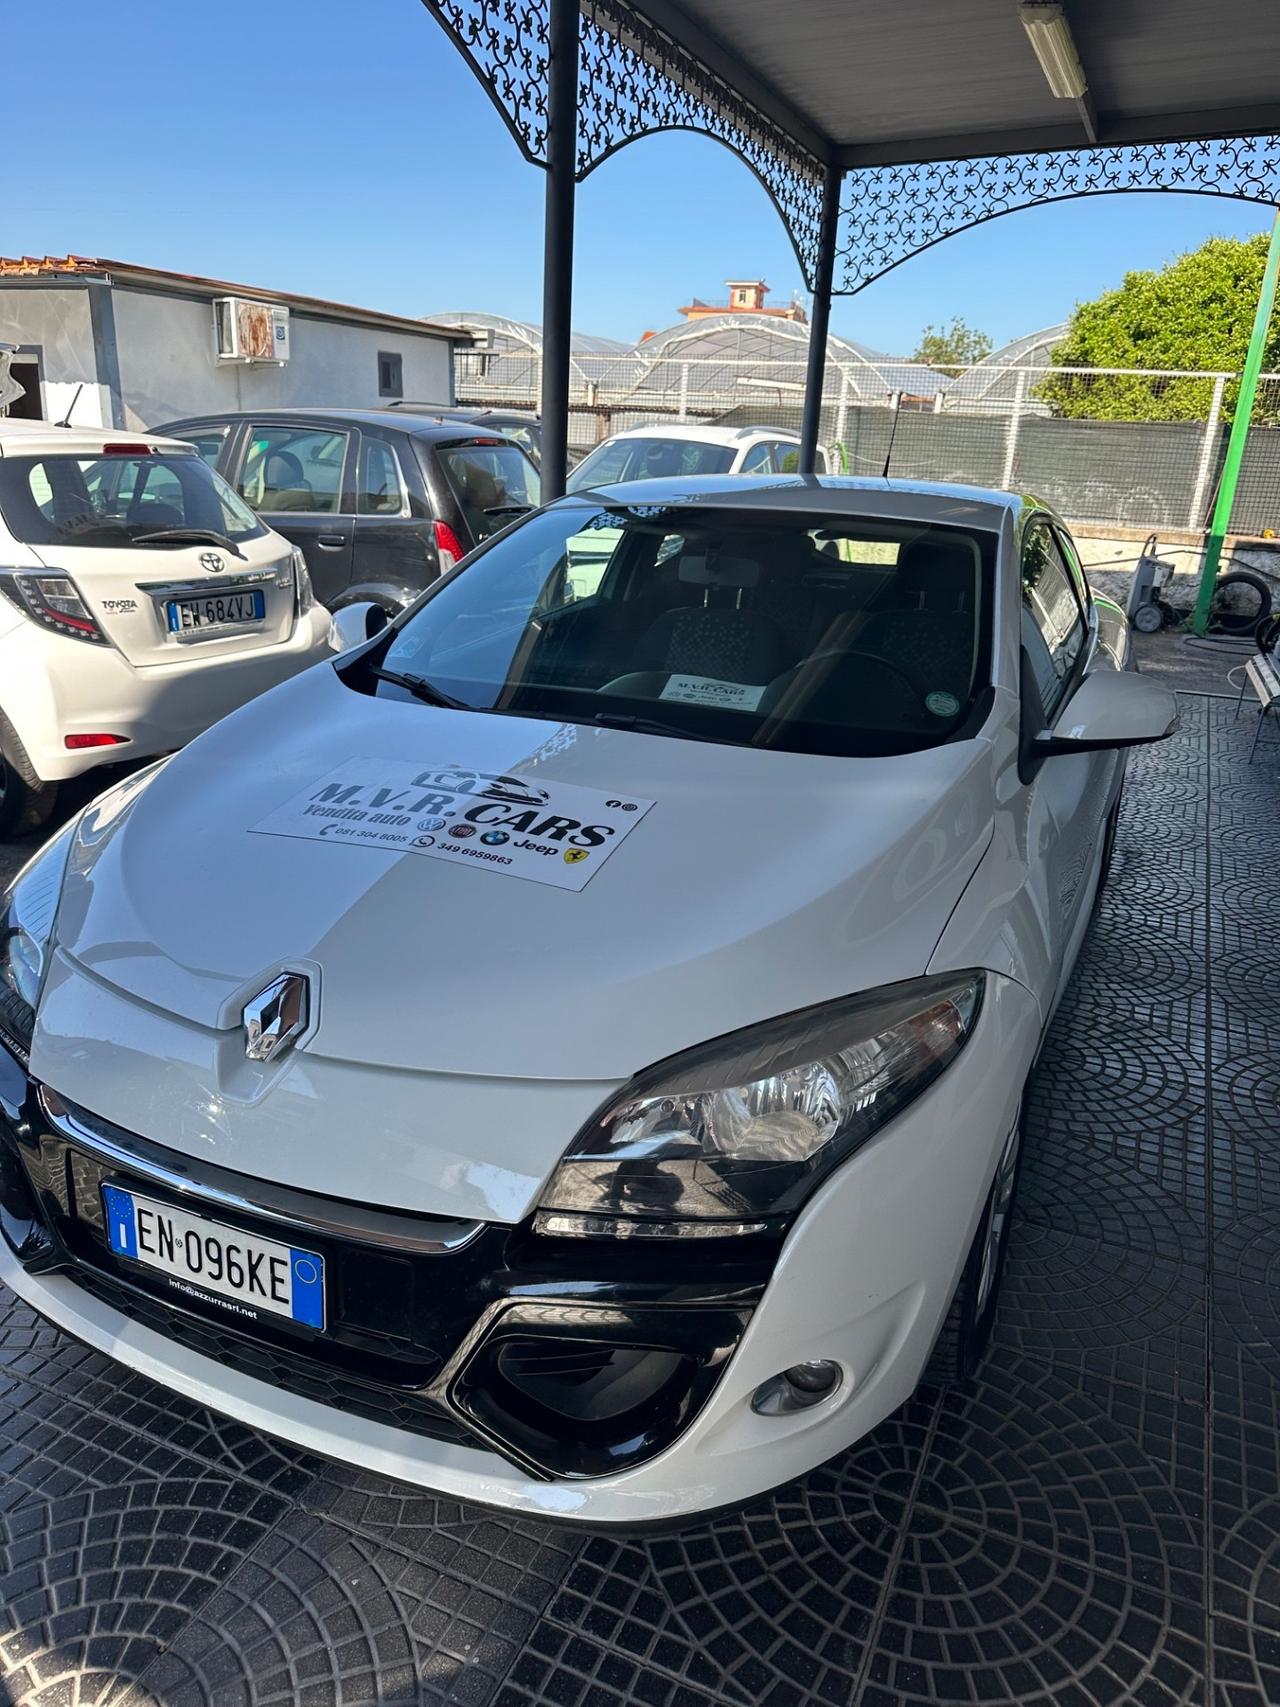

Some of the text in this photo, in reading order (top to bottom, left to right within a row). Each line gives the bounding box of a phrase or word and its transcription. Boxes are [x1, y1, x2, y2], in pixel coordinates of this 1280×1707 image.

[101, 599, 138, 609] TOYOTA
[207, 593, 254, 623] 684VJ
[303, 804, 411, 826] Vendita auto
[335, 827, 354, 836] 081
[354, 829, 377, 839] 304
[437, 842, 513, 865] 349 6959863
[513, 839, 559, 856] Jeep
[137, 1208, 174, 1262] EN
[185, 1230, 290, 1304] 096KE
